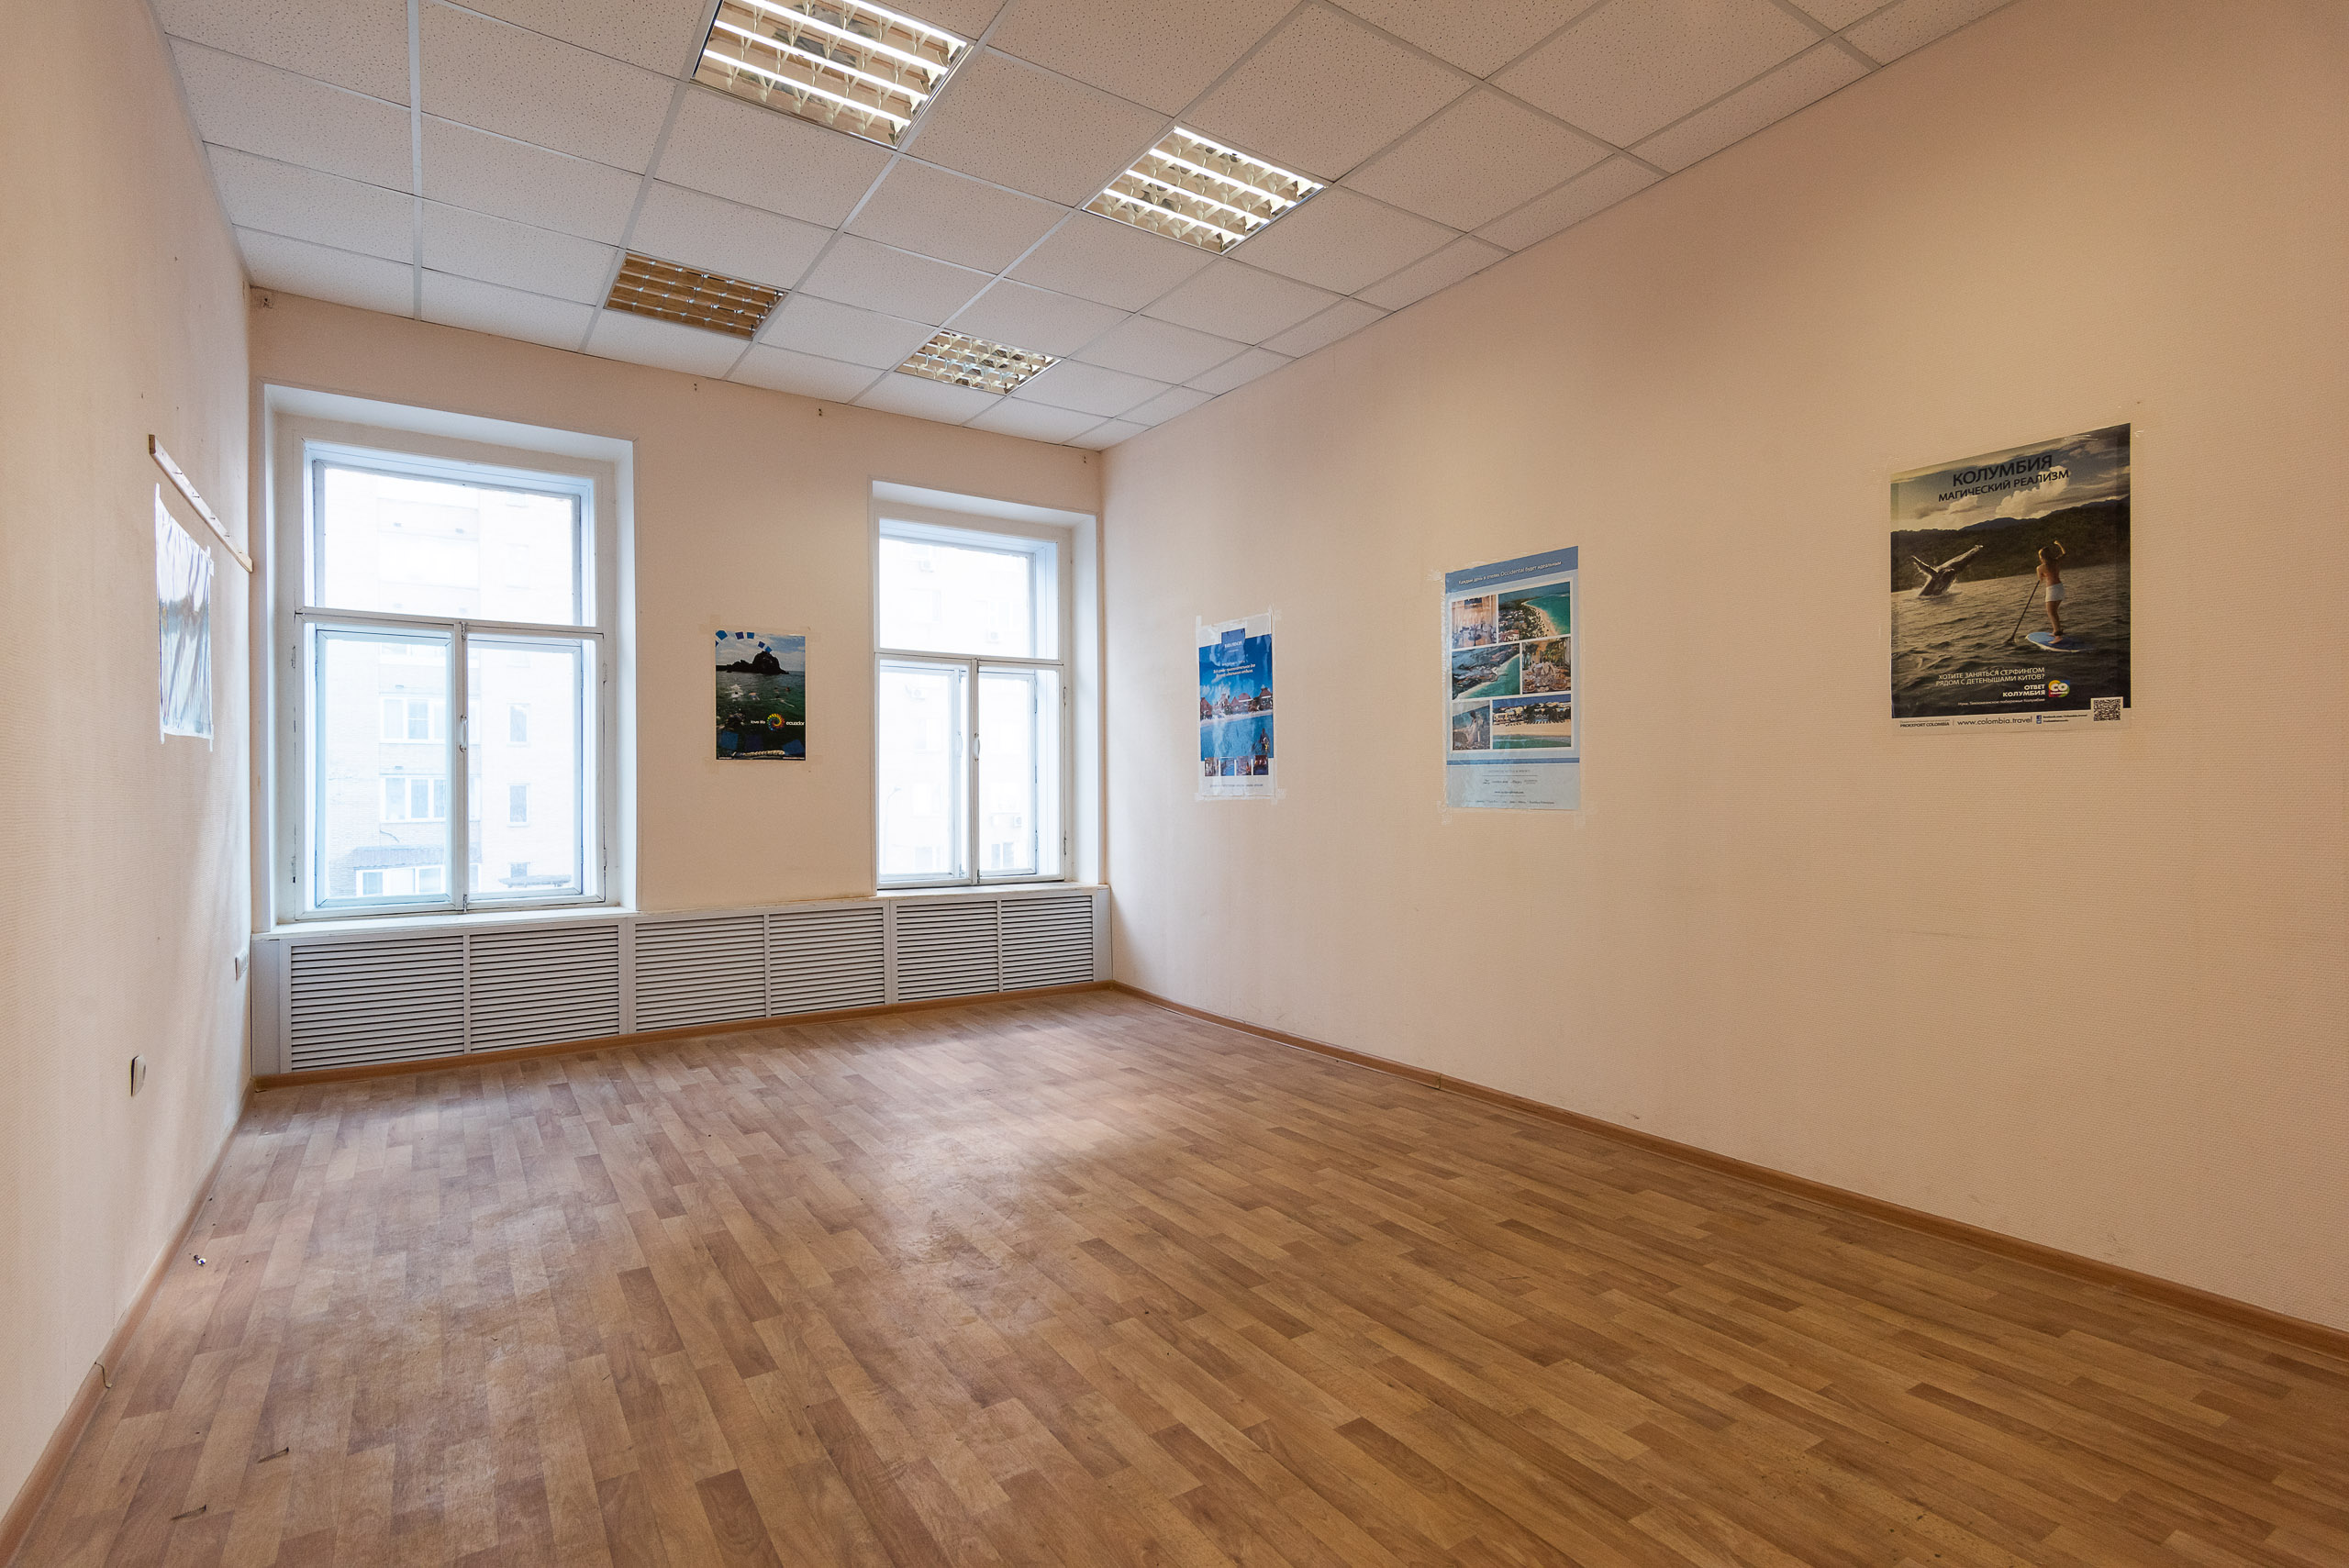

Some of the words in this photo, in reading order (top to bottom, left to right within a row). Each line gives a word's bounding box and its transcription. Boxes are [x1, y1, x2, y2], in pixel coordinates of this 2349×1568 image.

[1953, 455, 2053, 486] КОЛУМБИЯ
[1939, 480, 2010, 502] МАГИЧЕСКИЙ
[2014, 470, 2069, 488] РЕАЛИЗМ
[1500, 567, 1525, 577] Occidental
[1965, 670, 1998, 679] ЗАНЯТЬСЯ
[2000, 667, 2045, 676] СЕРФИНГОМ
[1966, 676, 2017, 685] ДЕТЕНЫШАМИ
[1957, 716, 2032, 726] www.colombia.travel
